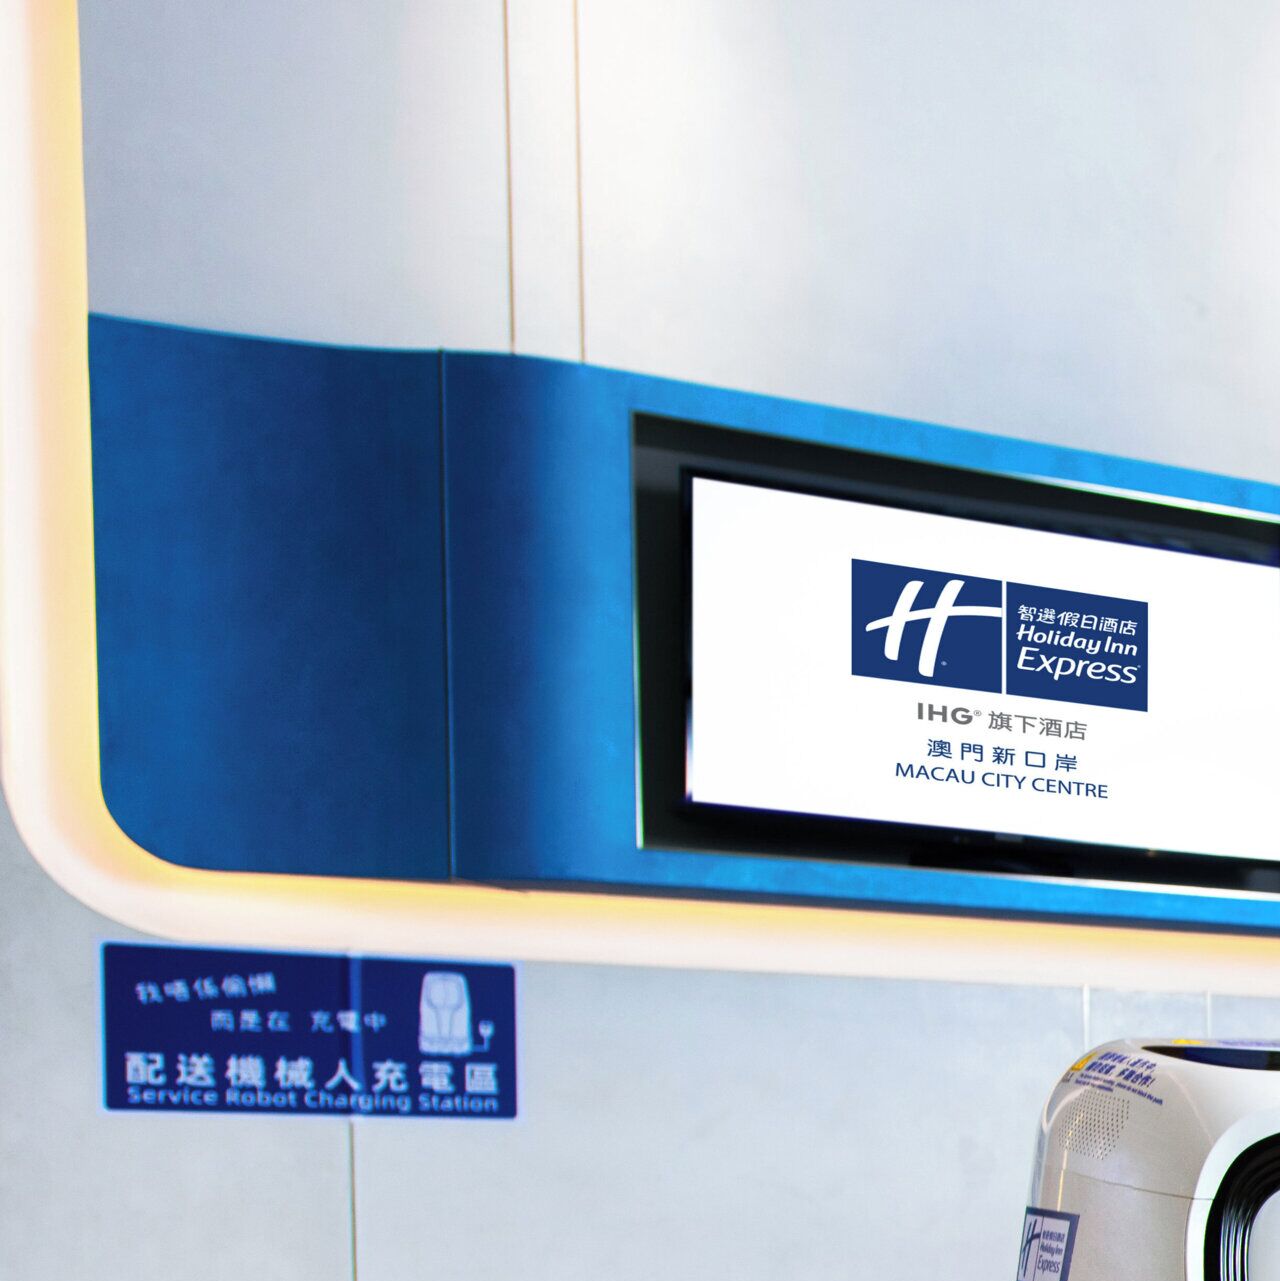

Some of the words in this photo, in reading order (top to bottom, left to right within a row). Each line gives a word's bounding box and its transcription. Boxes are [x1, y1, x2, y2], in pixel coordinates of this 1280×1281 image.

[1017, 604, 1138, 636] 智選假日酒店
[1016, 624, 1101, 654] Holiday
[1104, 634, 1138, 656] Inn
[1016, 646, 1138, 684] Express
[988, 710, 1087, 740] 旗下酒店
[927, 739, 1078, 772] 澳門新口岸
[895, 762, 975, 784] MACAU
[982, 772, 1026, 790] CITY
[1032, 778, 1108, 799] CENTRE
[124, 1050, 499, 1096] 配送機械人充電區
[126, 1085, 218, 1107] Service
[225, 1087, 297, 1108] Robot
[304, 1088, 411, 1113] Charging
[418, 1092, 499, 1113] Station
[1037, 1254, 1061, 1275] Express
